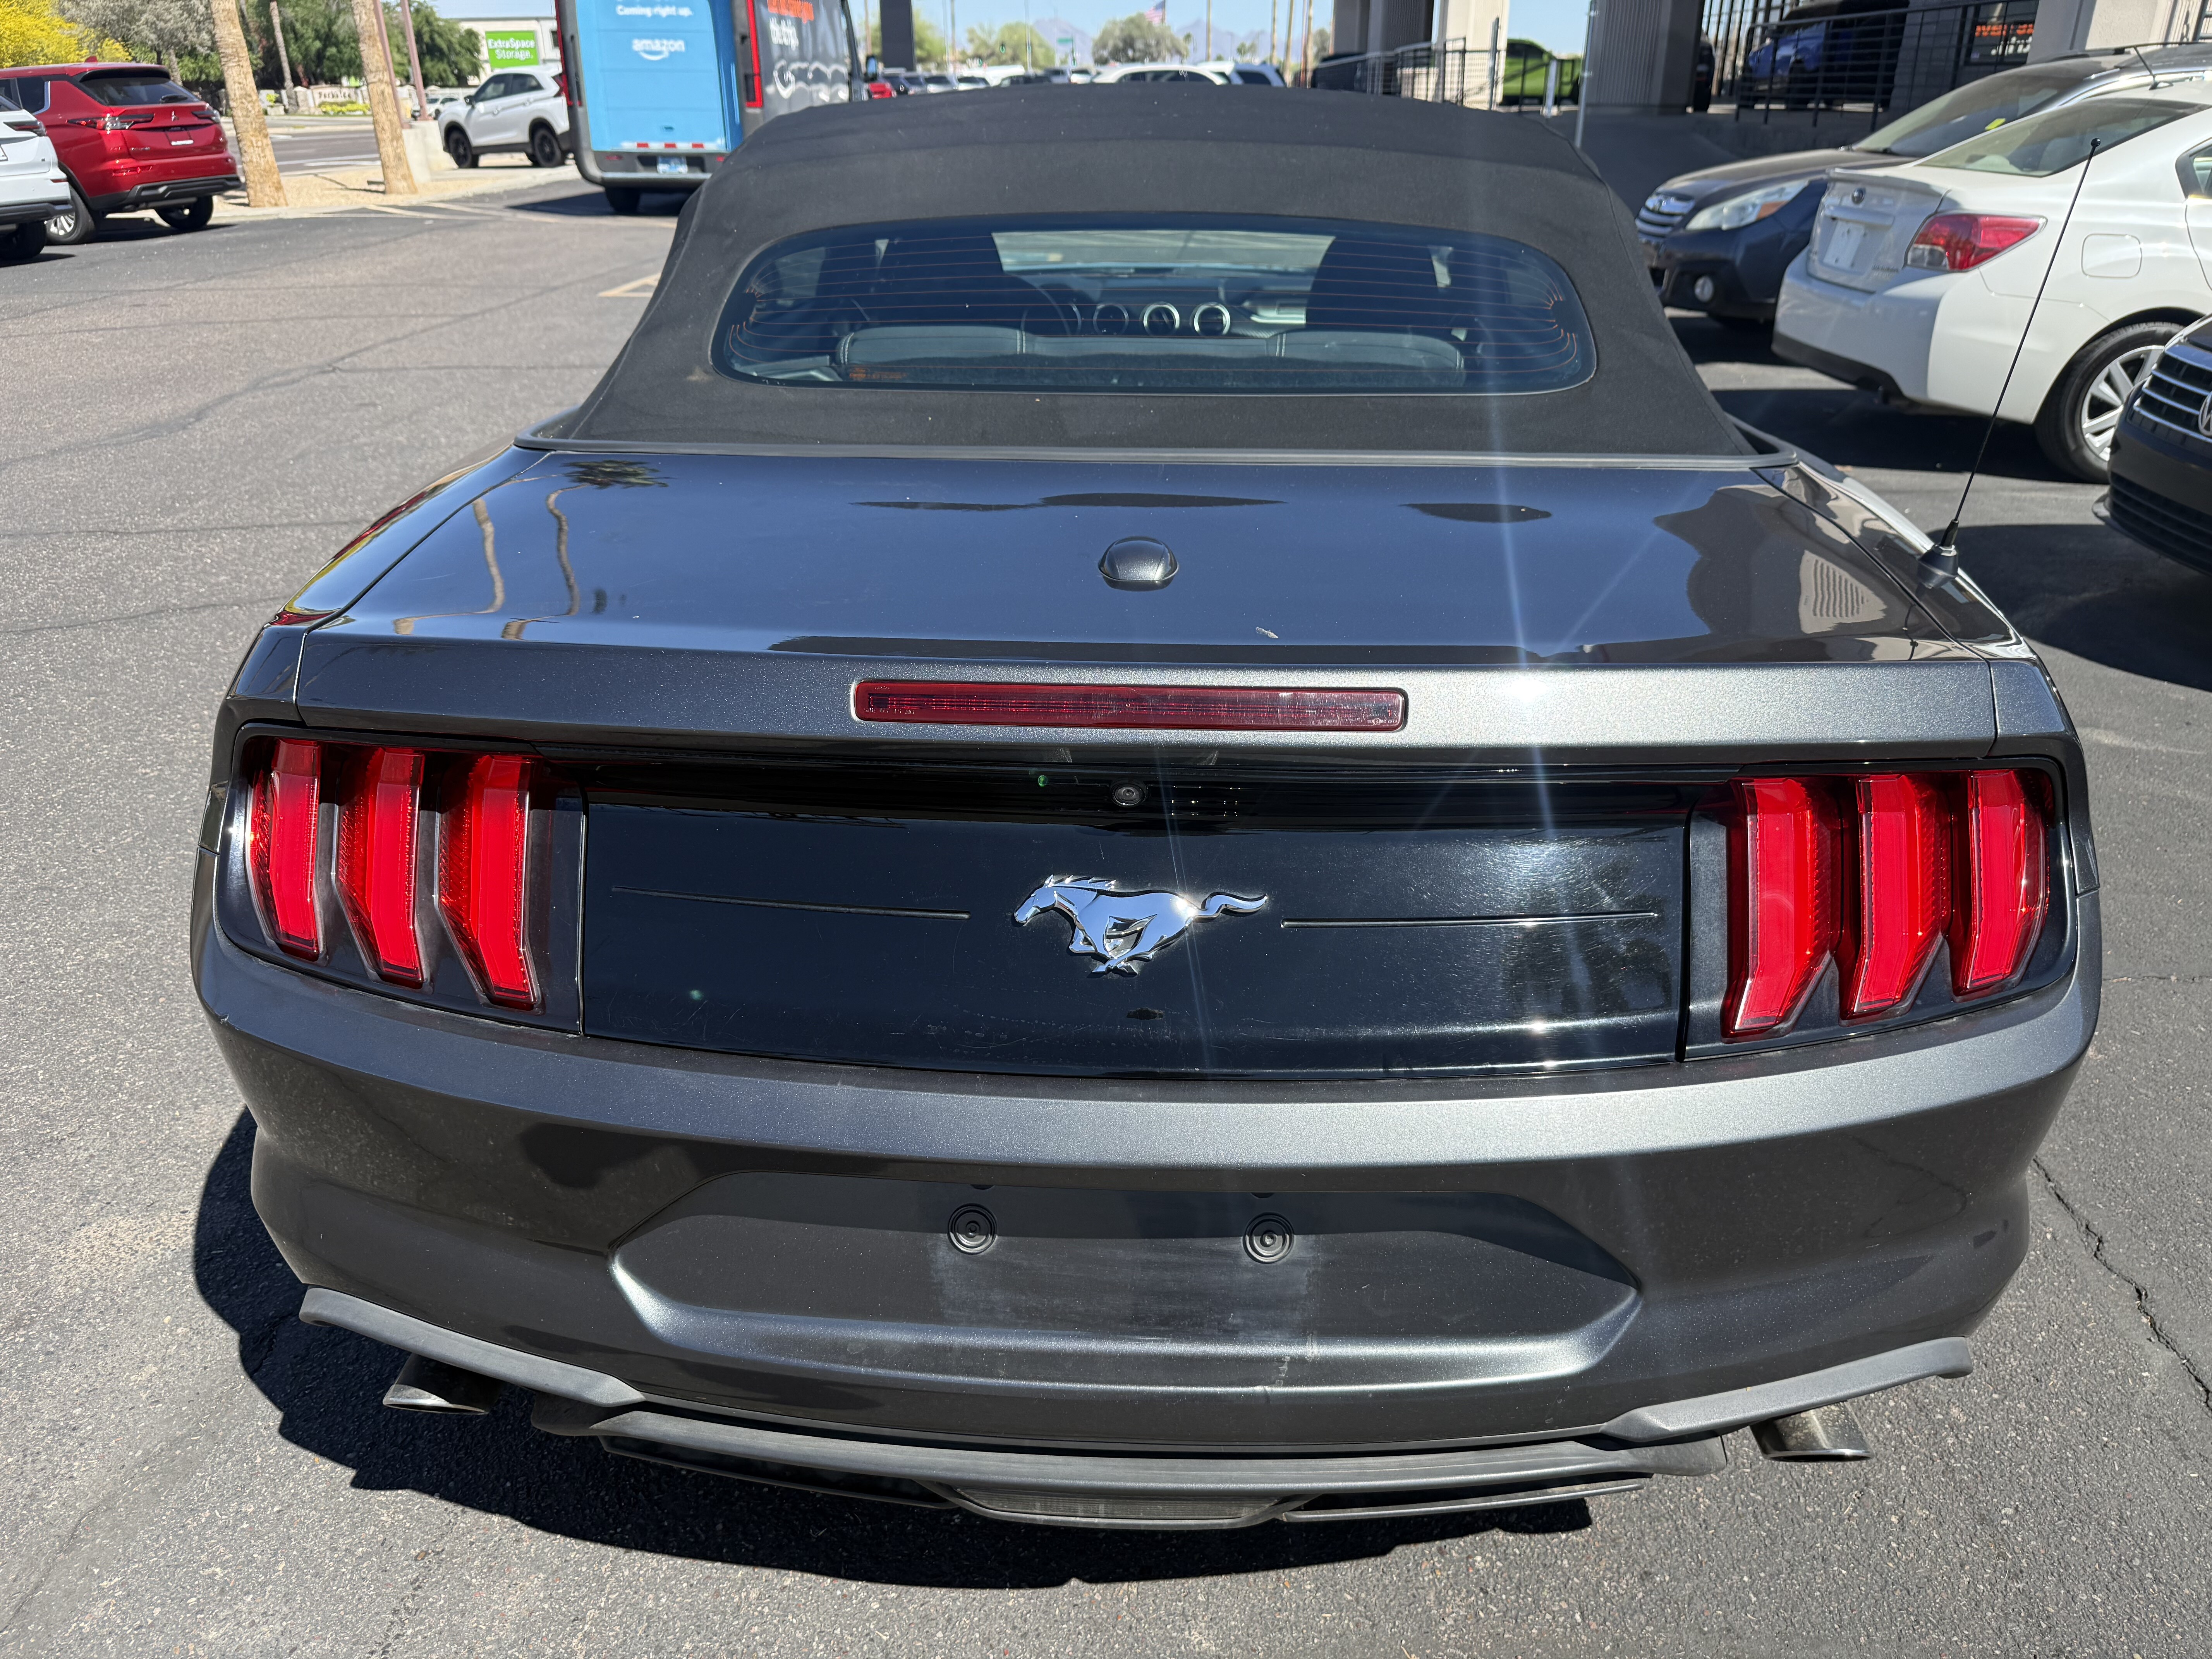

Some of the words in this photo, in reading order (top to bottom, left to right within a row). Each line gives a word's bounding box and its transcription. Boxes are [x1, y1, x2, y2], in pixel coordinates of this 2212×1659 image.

[616, 5, 652, 17] Coming
[653, 5, 677, 17] right
[678, 7, 694, 17] up.
[632, 39, 685, 52] amazon
